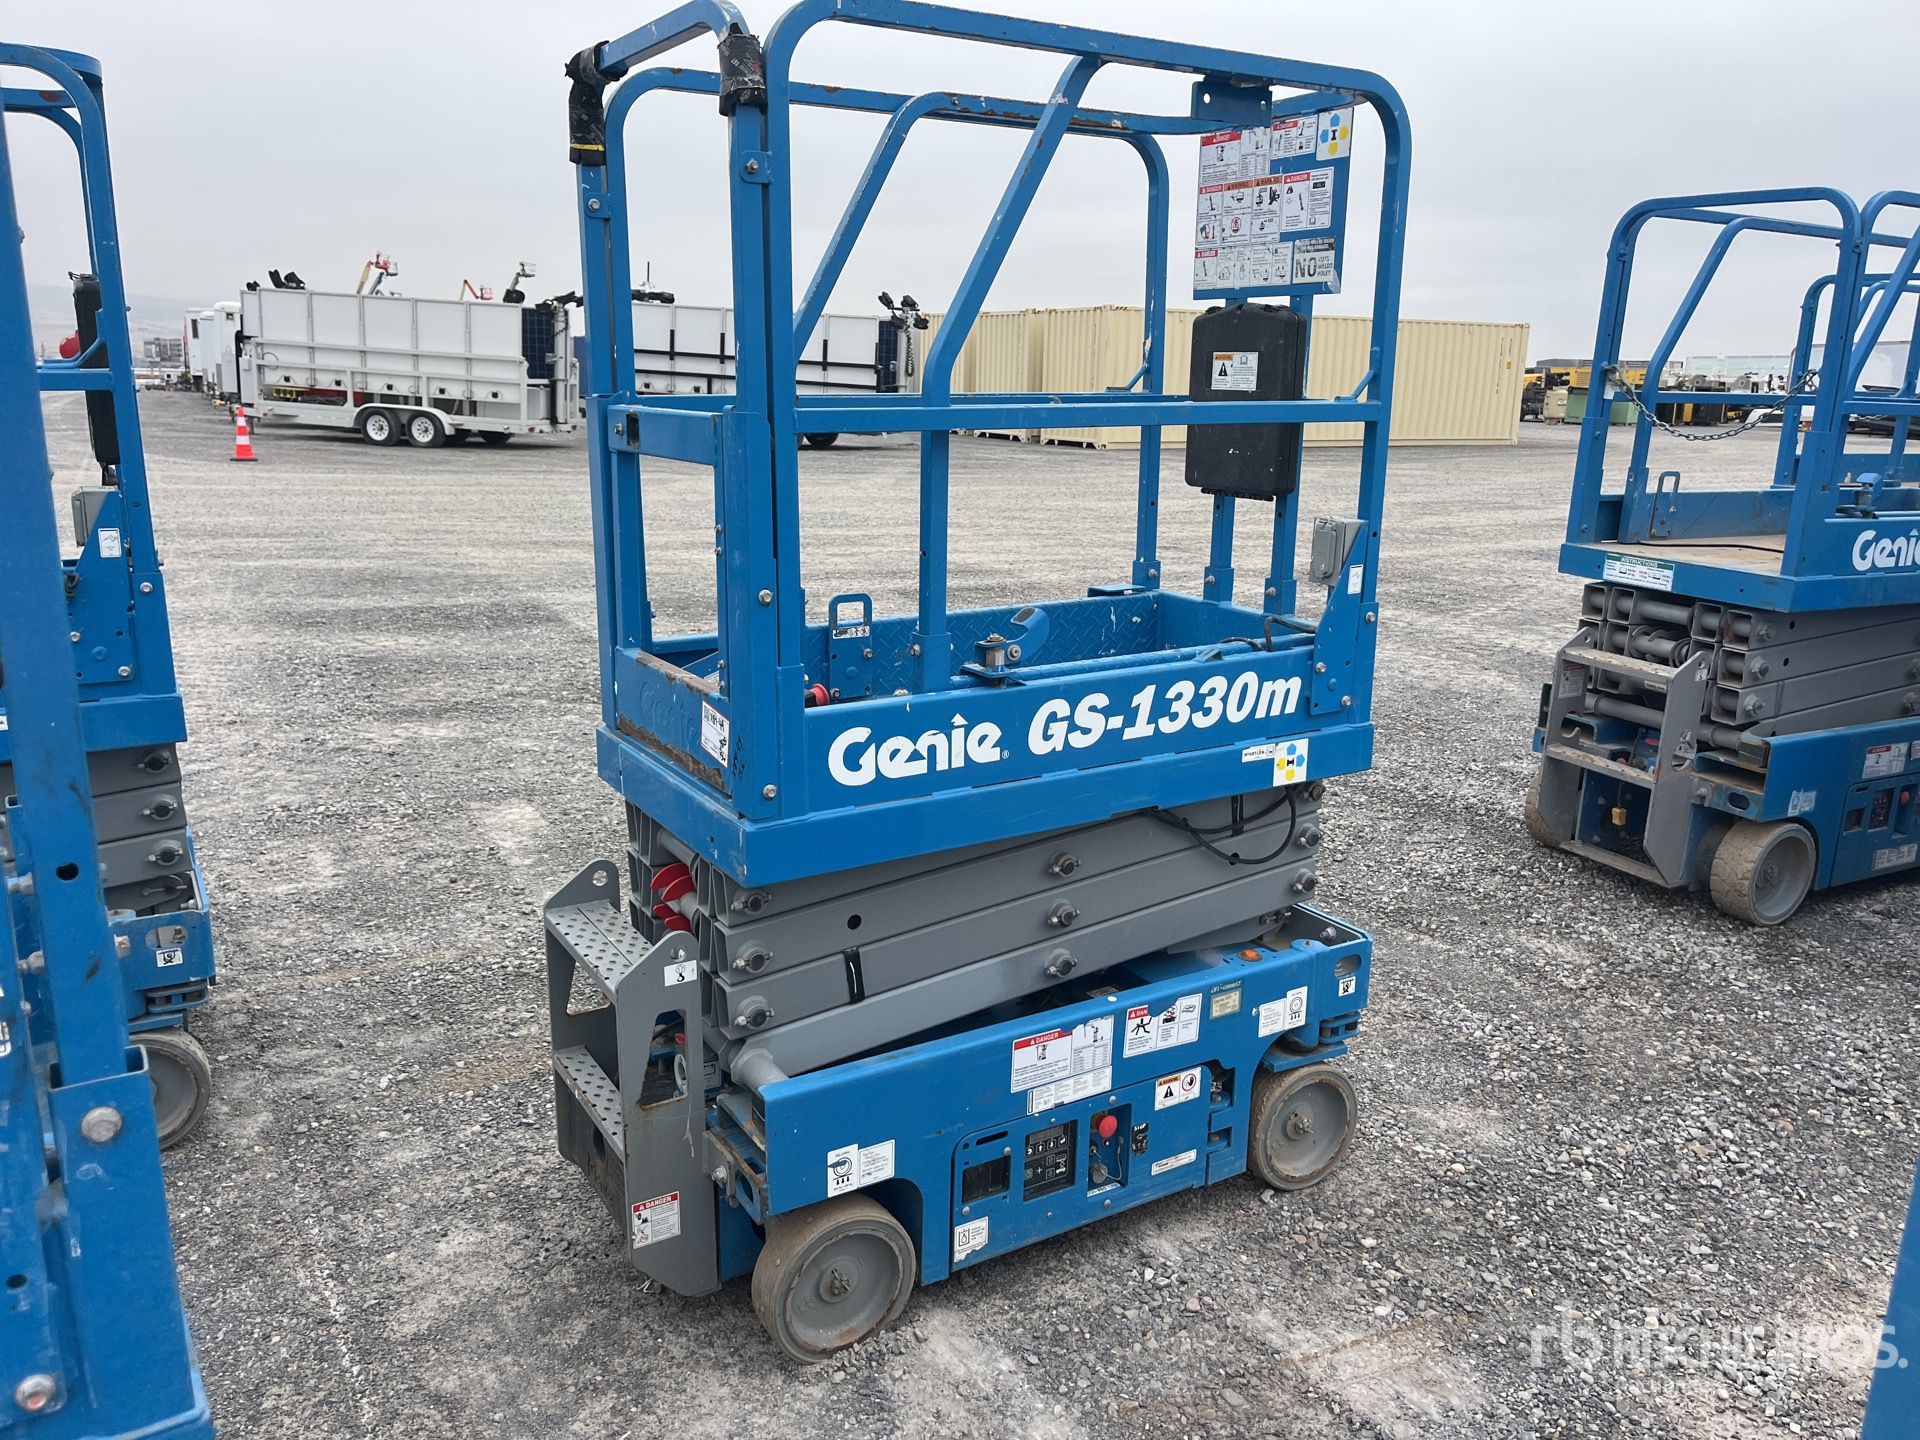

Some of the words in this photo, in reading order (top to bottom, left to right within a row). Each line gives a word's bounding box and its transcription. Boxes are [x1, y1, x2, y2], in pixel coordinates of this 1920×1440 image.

[1294, 256, 1318, 278] NO
[827, 712, 1002, 786] Genie
[1027, 671, 1303, 756] GS-1330m
[1035, 1032, 1059, 1044] DANGER
[645, 1195, 672, 1209] DANGER
